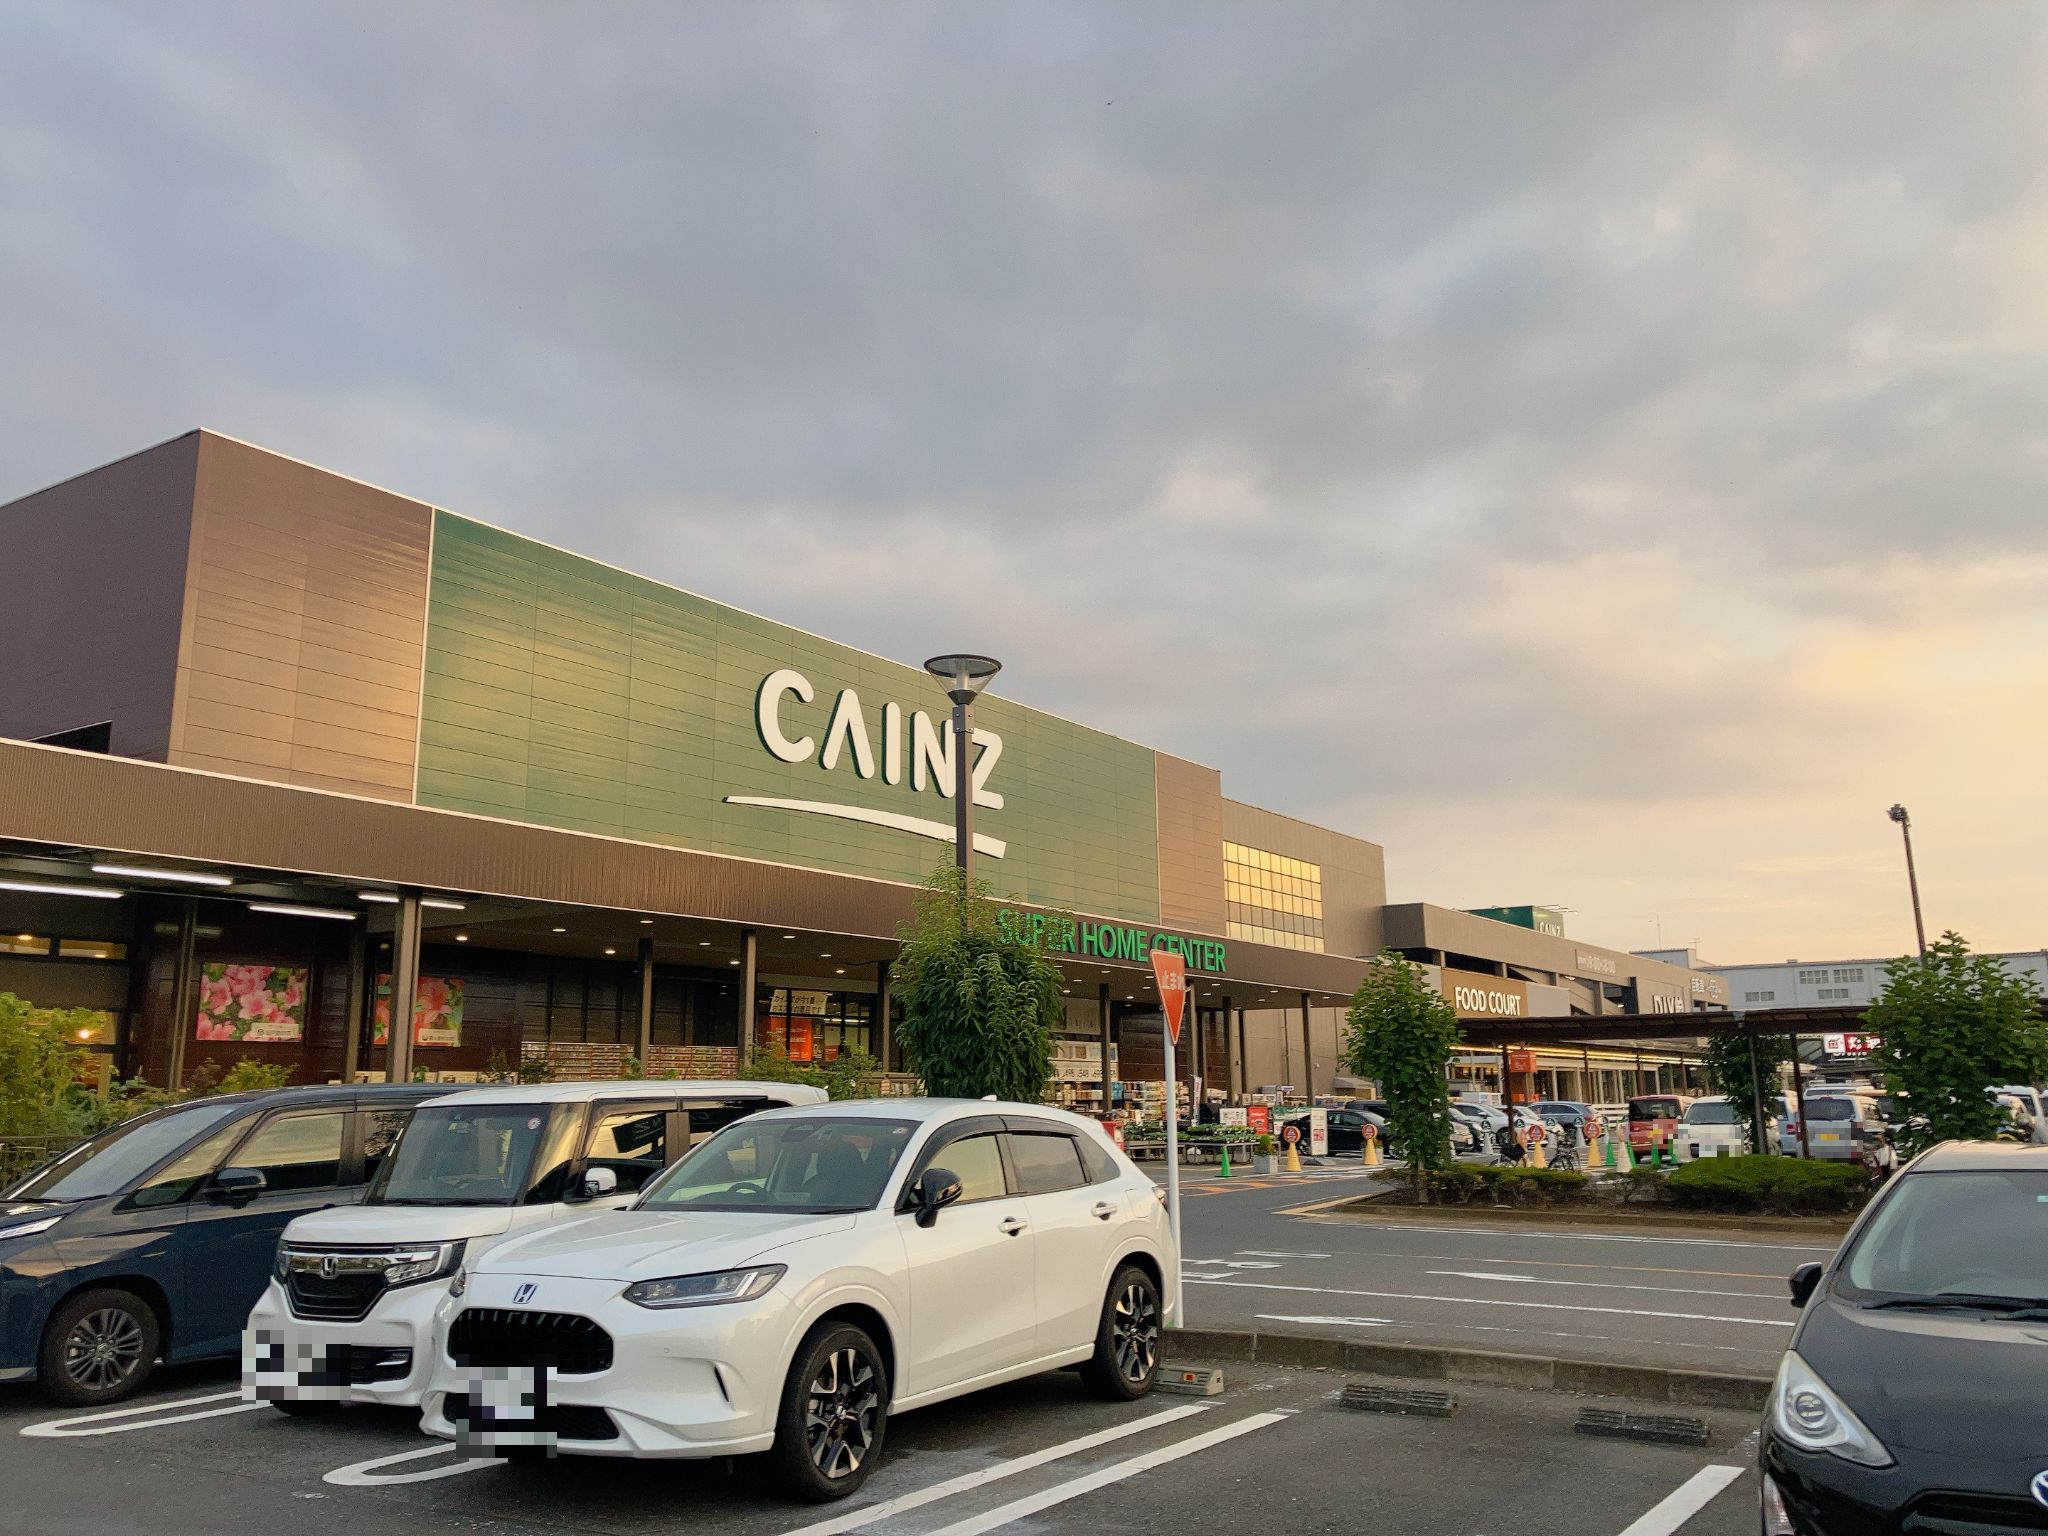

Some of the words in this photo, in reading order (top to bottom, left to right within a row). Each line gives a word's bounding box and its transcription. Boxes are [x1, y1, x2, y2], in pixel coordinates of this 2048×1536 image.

[756, 669, 1005, 810] CAINZ
[1081, 921, 1149, 962] HOME
[1151, 933, 1227, 972] CENTER
[1454, 986, 1487, 1012] FOOD
[1488, 991, 1521, 1017] COURT
